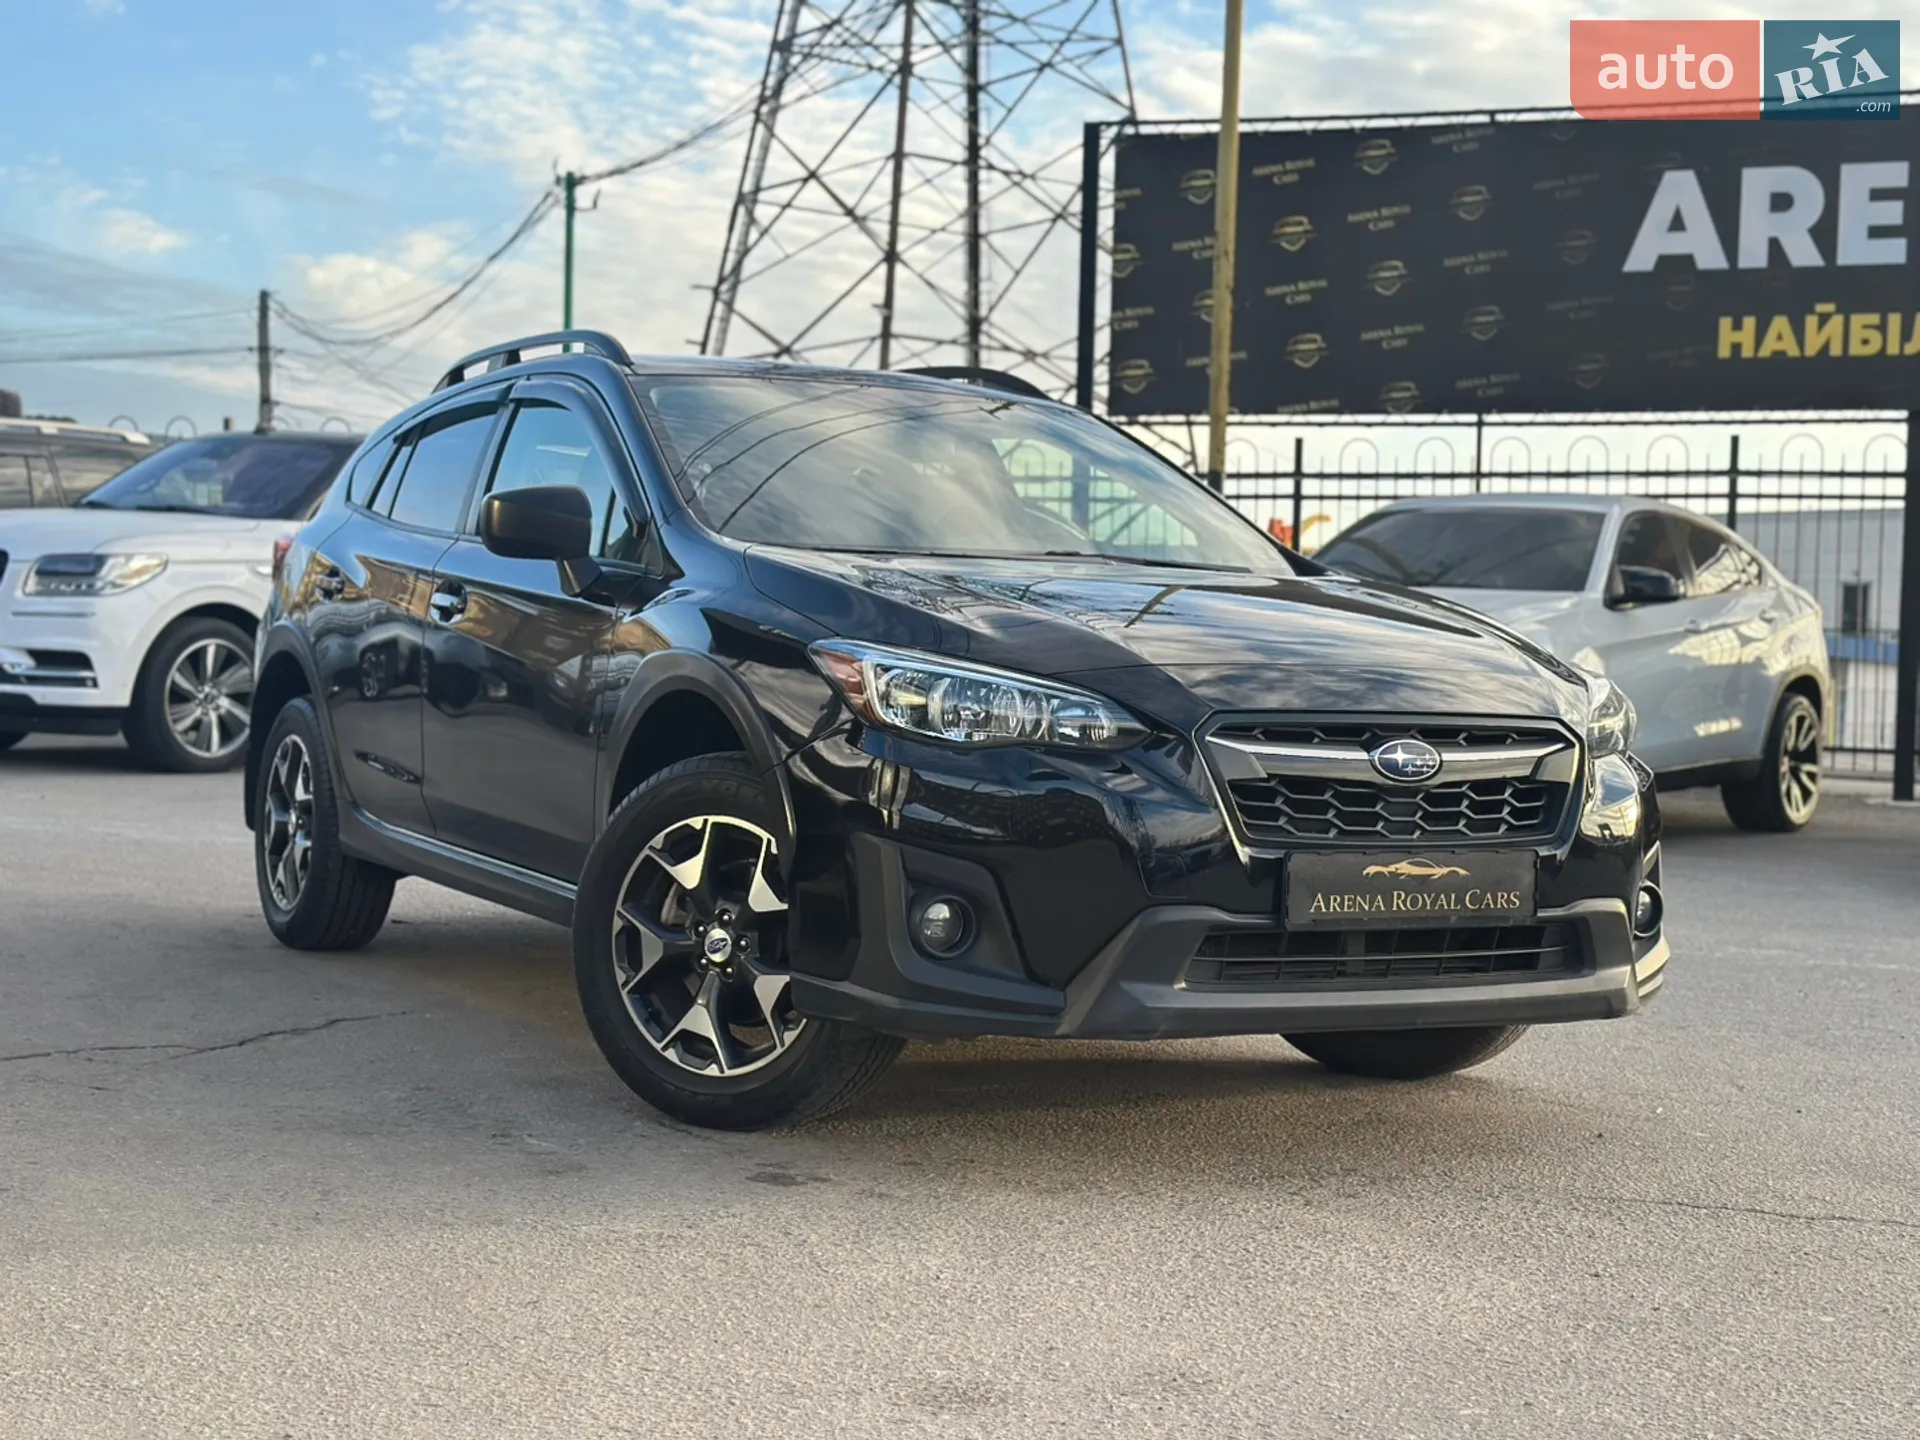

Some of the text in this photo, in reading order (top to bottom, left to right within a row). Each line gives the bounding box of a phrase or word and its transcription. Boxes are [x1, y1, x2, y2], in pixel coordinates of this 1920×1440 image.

[1622, 161, 1910, 272] ARE
[1309, 889, 1520, 913] ARENA ROYAL CARS
